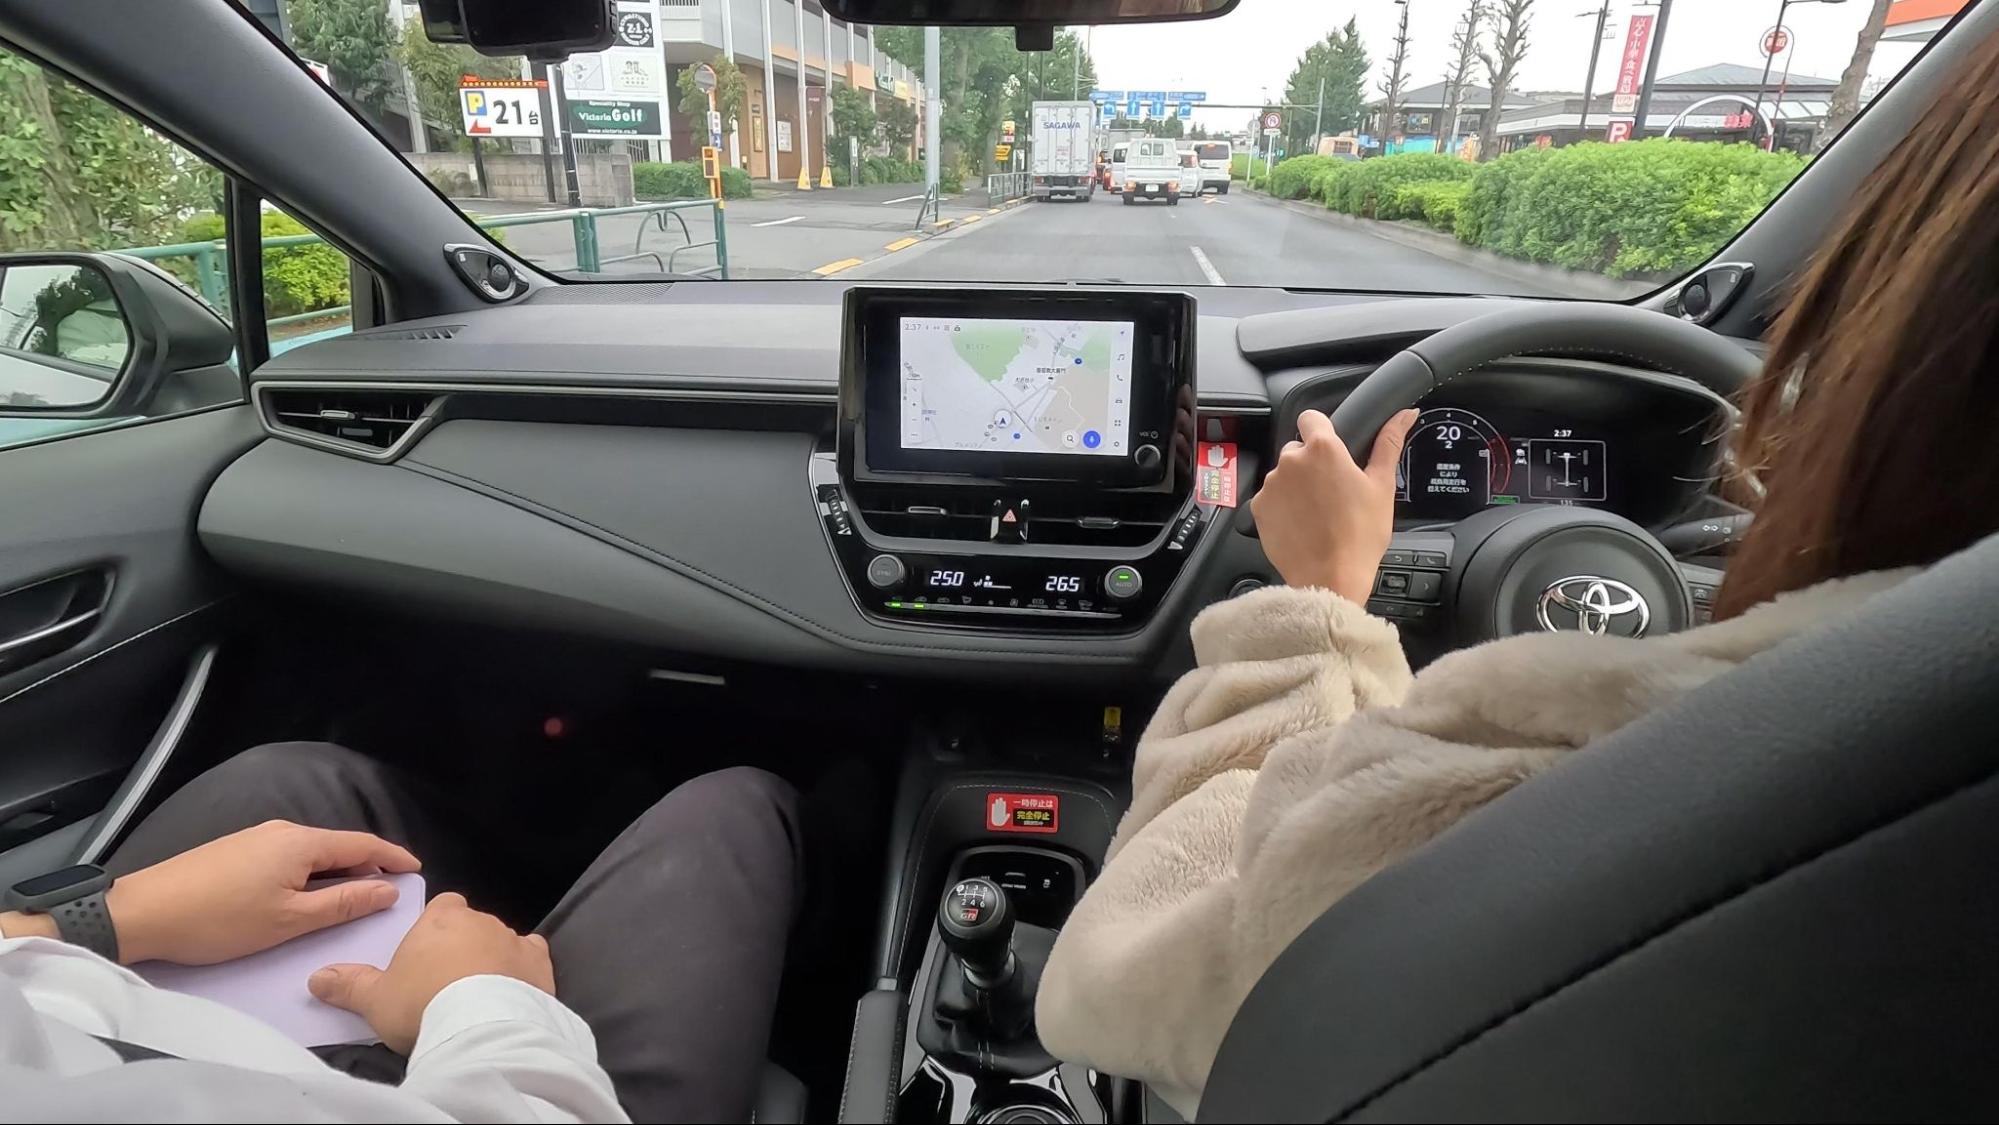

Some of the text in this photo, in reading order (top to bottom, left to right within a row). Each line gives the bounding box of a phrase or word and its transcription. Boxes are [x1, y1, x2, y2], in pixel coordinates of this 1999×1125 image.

[467, 92, 482, 114] P
[493, 100, 539, 125] 21 台
[611, 108, 643, 122] Golf
[1043, 121, 1081, 130] SAGAWA
[1609, 122, 1628, 142] P
[904, 323, 921, 331] 2:37
[1436, 426, 1461, 441] 20
[1553, 429, 1572, 438] 2:37
[1444, 440, 1453, 449] 2
[1013, 798, 1054, 808] 一時停止は
[1016, 811, 1050, 821] 完全停止
[961, 898, 967, 906] 2
